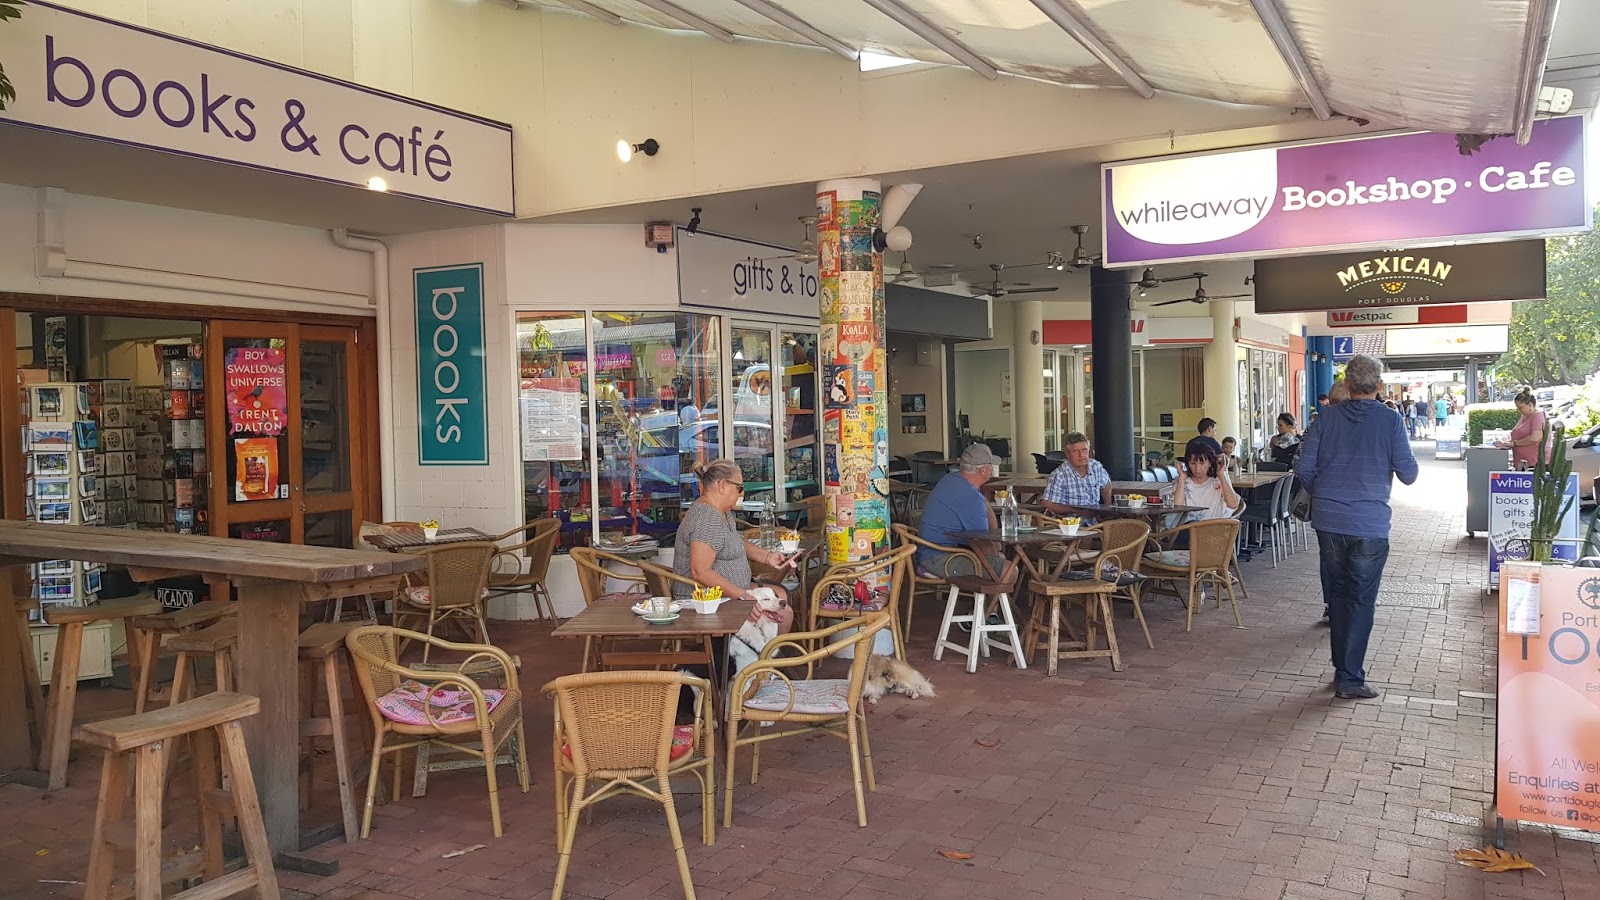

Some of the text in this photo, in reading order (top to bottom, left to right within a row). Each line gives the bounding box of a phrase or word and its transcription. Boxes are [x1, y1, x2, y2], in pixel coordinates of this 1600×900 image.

[45, 35, 452, 182] books & café
[1281, 161, 1576, 212] Bookshop Cafe
[1120, 196, 1268, 226] whileaway
[733, 256, 819, 297] gifts & to
[1336, 256, 1453, 287] MEXICAN
[1386, 295, 1430, 303] DOUGLAS
[1332, 311, 1393, 324] Westpac
[842, 324, 868, 335] KOALA
[244, 351, 266, 360] BOY
[227, 364, 284, 374] SWALLOWS
[431, 286, 469, 444] books
[230, 377, 283, 387] UNIVERSE
[239, 409, 278, 419] TRENT
[235, 421, 283, 433] DALTON
[1495, 496, 1529, 505] books
[1503, 508, 1526, 518] gifts
[156, 589, 194, 608] PICADOR
[1562, 611, 1598, 628] Port
[1551, 757, 1600, 774] All Wel
[1508, 771, 1600, 794] Enquiries at
[1519, 804, 1548, 816] follow
[1550, 809, 1564, 818] us
